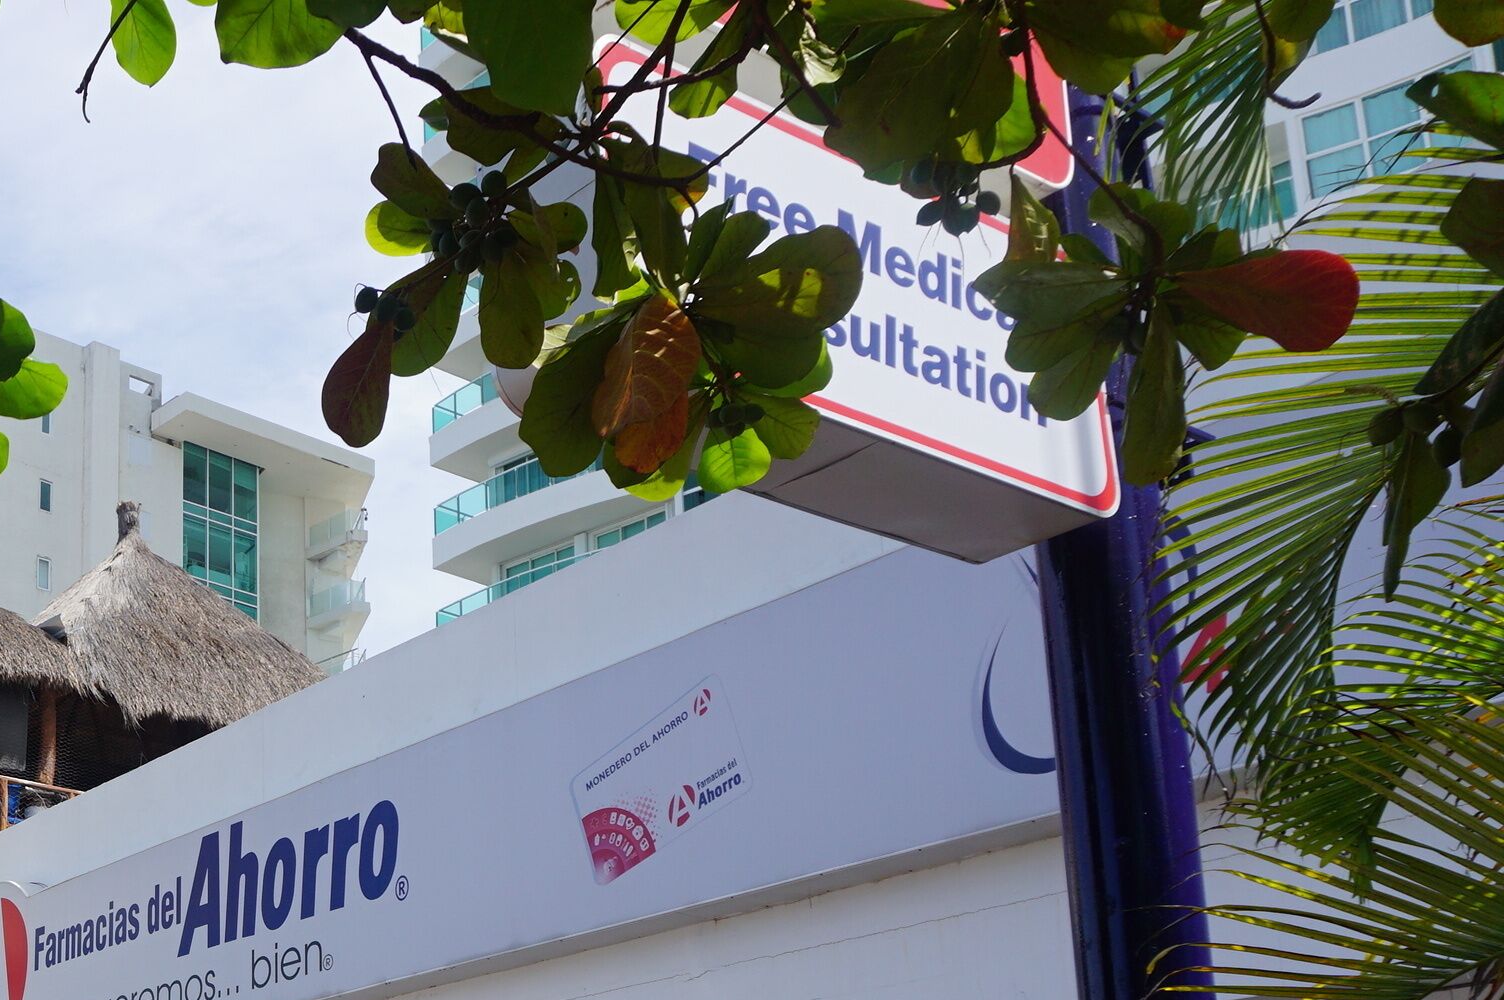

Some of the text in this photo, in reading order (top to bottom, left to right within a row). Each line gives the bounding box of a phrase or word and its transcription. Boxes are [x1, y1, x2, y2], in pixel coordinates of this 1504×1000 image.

[837, 208, 1020, 332] Medic
[824, 313, 1048, 428] sultation
[585, 711, 689, 791] MONEDERO DEL AHORRO
[697, 758, 738, 791] Farmacias del
[698, 772, 742, 810] Ahorro
[34, 900, 139, 971] Farmacias
[147, 876, 182, 935] del
